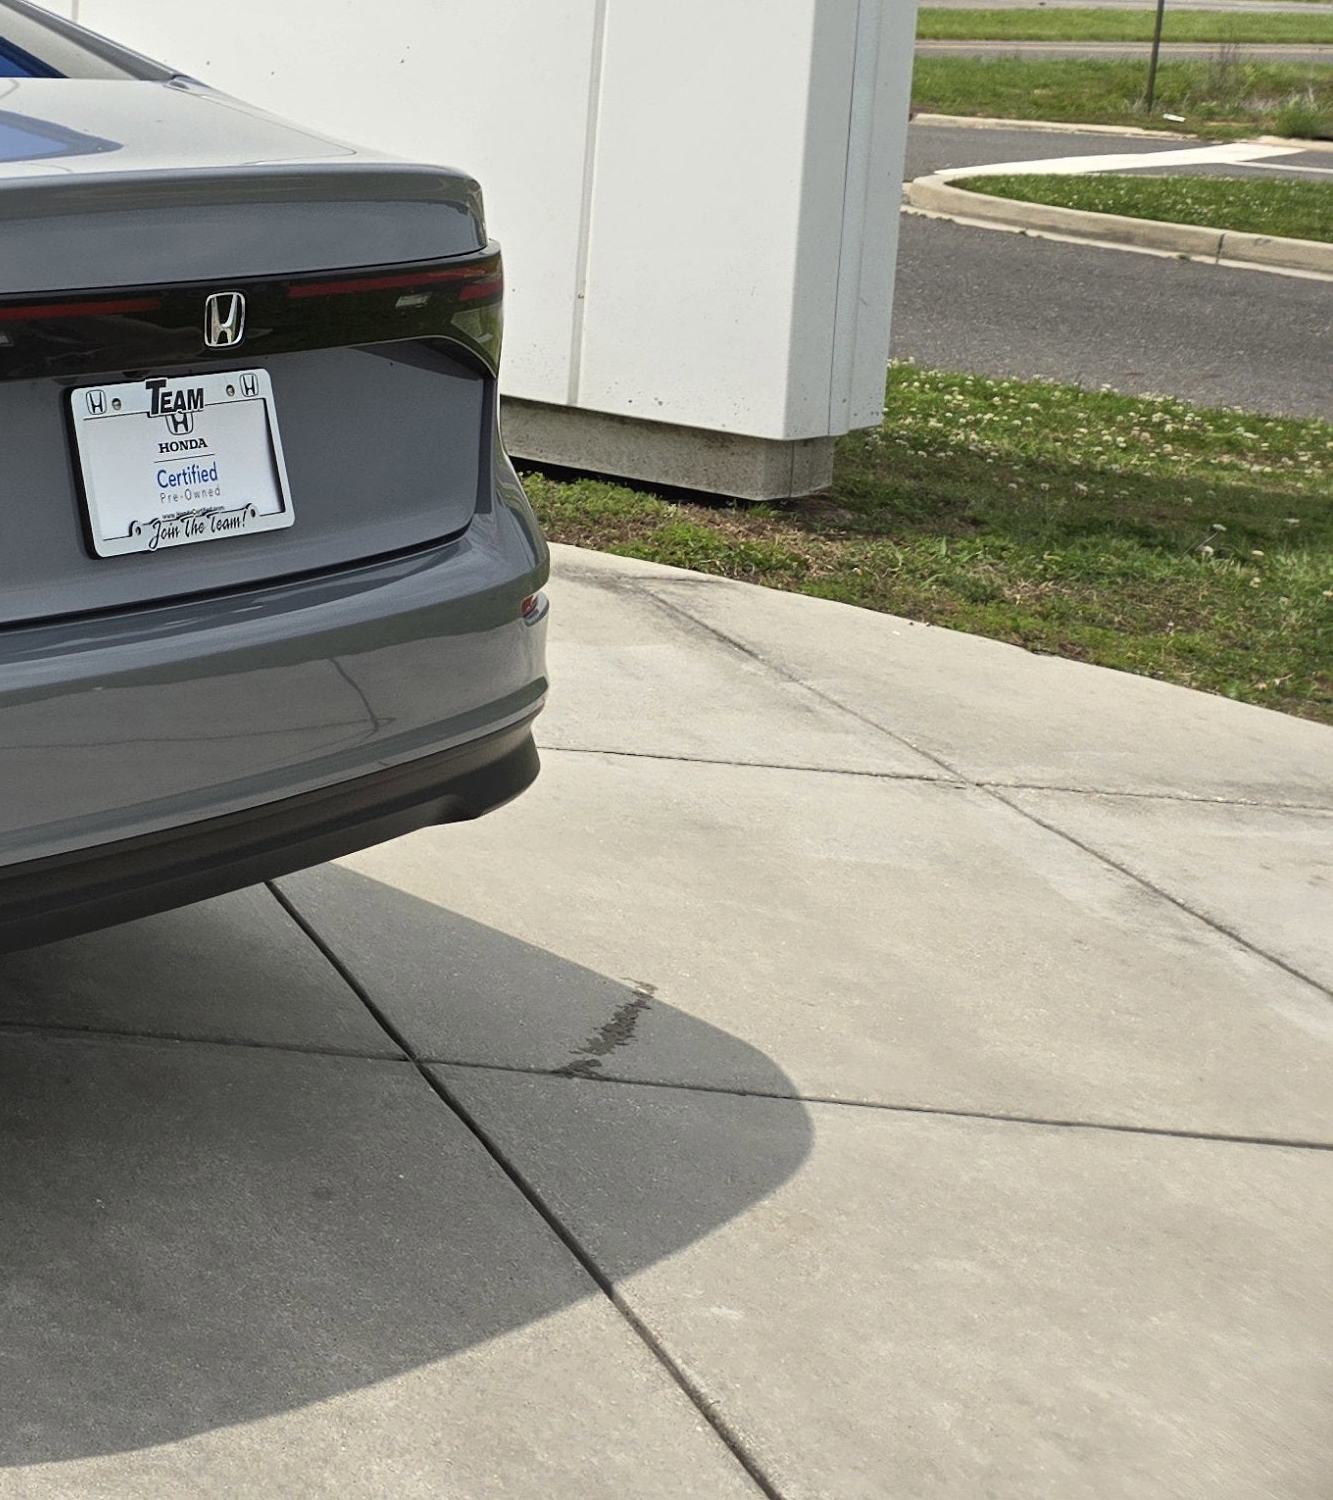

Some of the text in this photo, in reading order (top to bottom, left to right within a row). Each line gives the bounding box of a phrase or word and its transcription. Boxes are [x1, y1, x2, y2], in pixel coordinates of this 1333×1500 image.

[145, 379, 204, 415] TEAM
[158, 438, 208, 454] HONDA
[157, 461, 218, 488] Certified
[160, 484, 221, 503] Pre-Owned
[149, 520, 180, 549] Join
[180, 516, 206, 538] The
